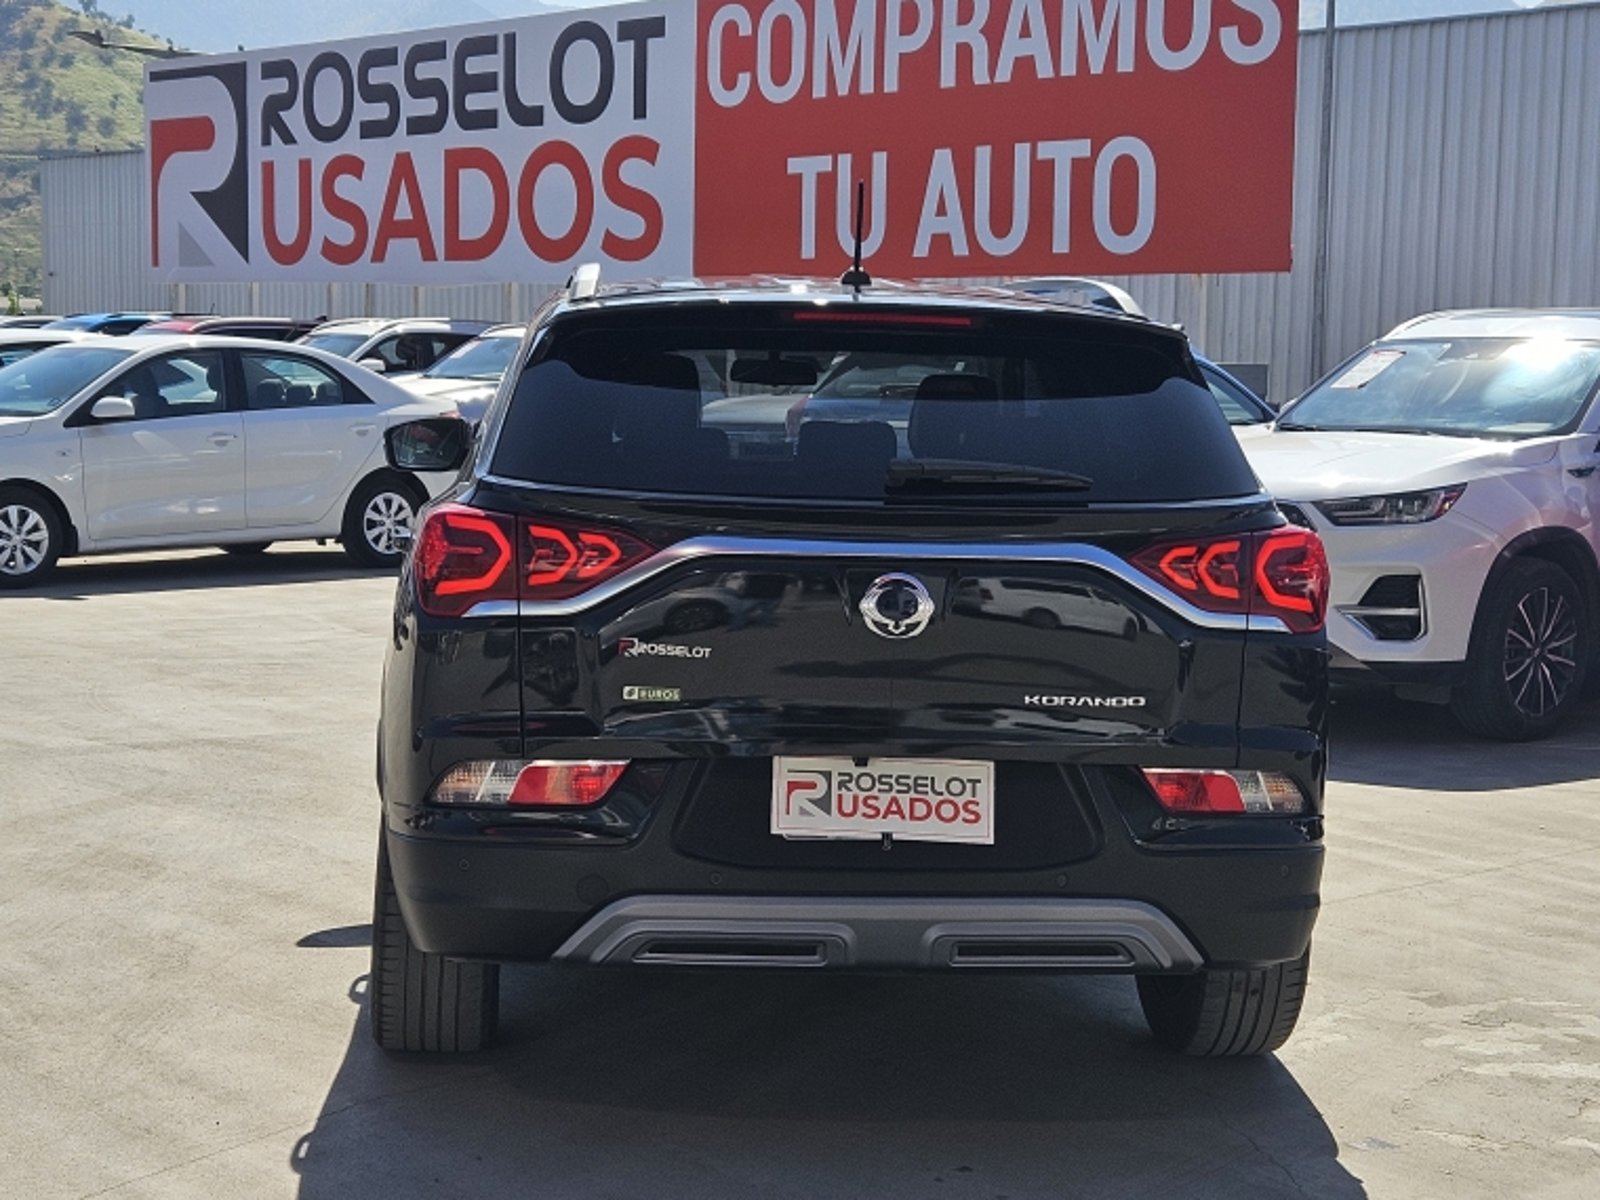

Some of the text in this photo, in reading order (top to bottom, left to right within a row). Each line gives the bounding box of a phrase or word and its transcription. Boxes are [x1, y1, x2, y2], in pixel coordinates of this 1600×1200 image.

[260, 15, 666, 146] ROSSELOT
[707, 0, 1283, 107] COMPRAMOS
[261, 134, 664, 265] USADOS
[787, 136, 1156, 259] TU AUTO
[1023, 694, 1146, 708] KORANDO
[837, 771, 982, 798] ROSSELOT
[837, 793, 982, 824] USADOS
